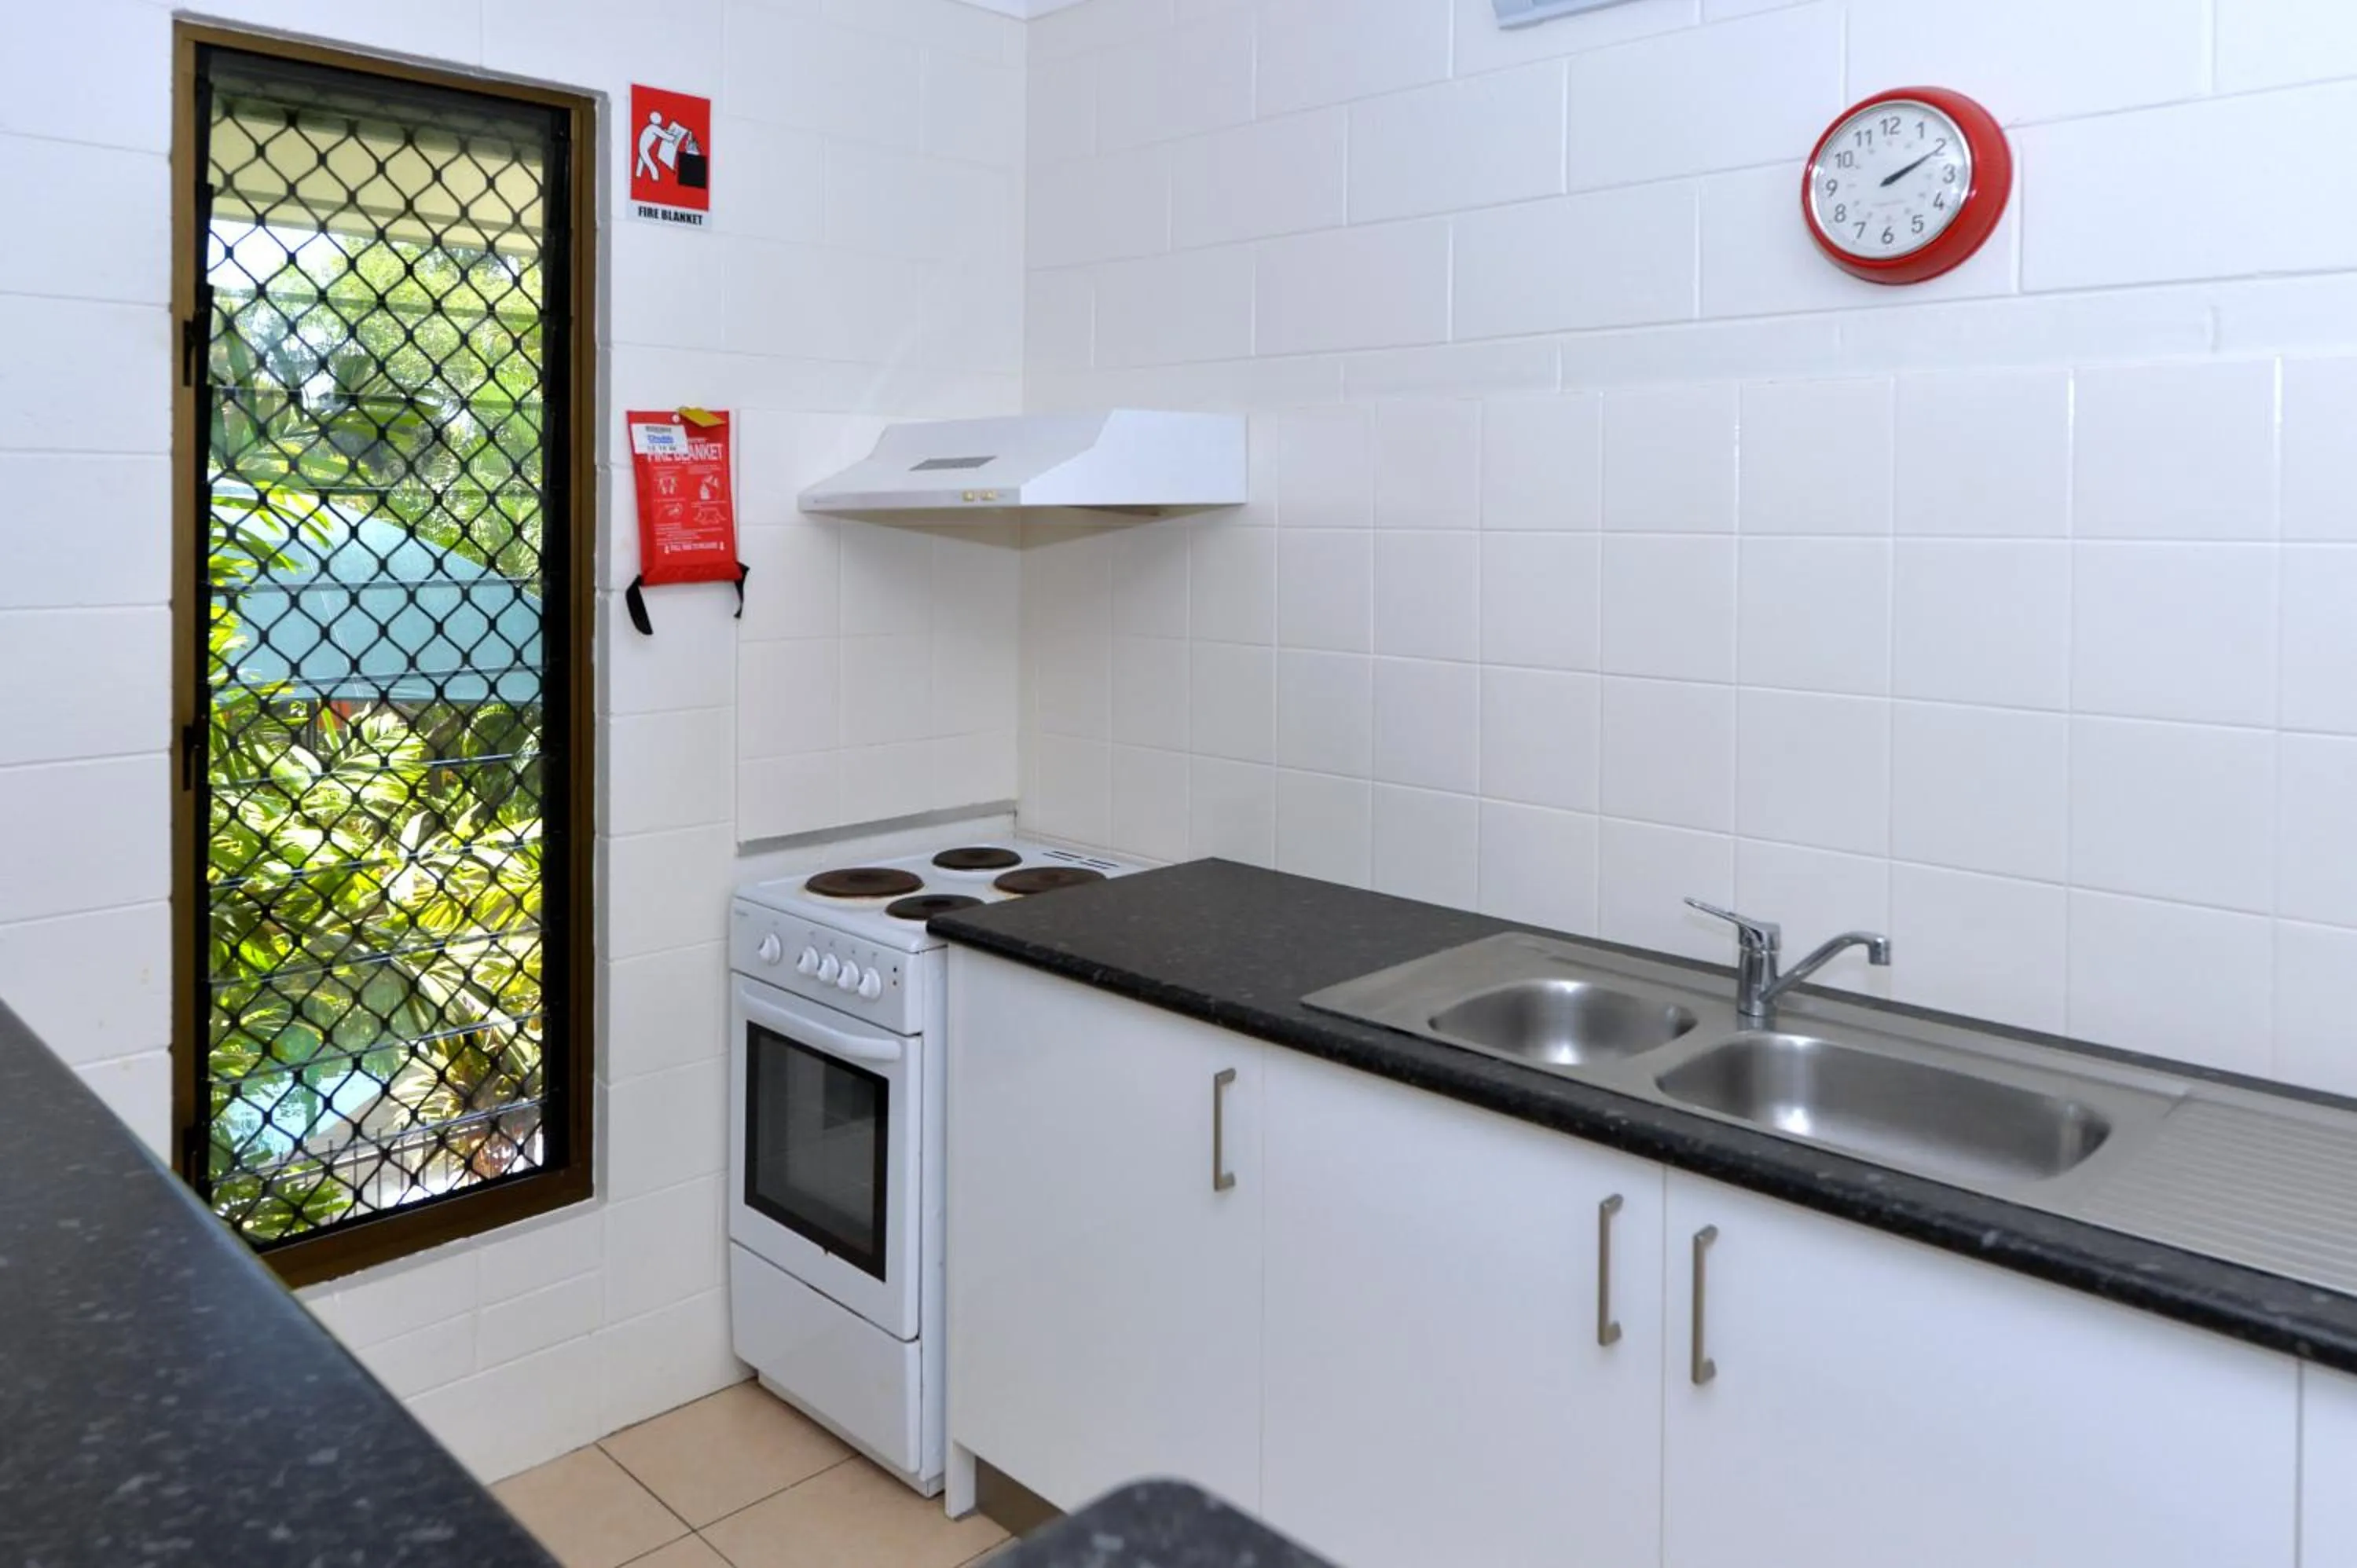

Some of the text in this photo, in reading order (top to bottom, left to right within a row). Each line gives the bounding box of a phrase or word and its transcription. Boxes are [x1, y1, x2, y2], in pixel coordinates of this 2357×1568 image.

[1879, 116, 1901, 135] 12
[1915, 122, 1924, 139] 1
[1854, 130, 1872, 147] 11
[1934, 137, 1947, 156] 2
[1835, 150, 1853, 168] 10
[1942, 163, 1956, 184] 3
[1825, 179, 1838, 197] 9
[1933, 192, 1945, 211] 4
[637, 206, 703, 225] FIRE BLANKET
[1834, 203, 1846, 222] 8
[1853, 221, 1867, 239] 7
[1911, 214, 1923, 233] 5
[1880, 226, 1894, 244] 6
